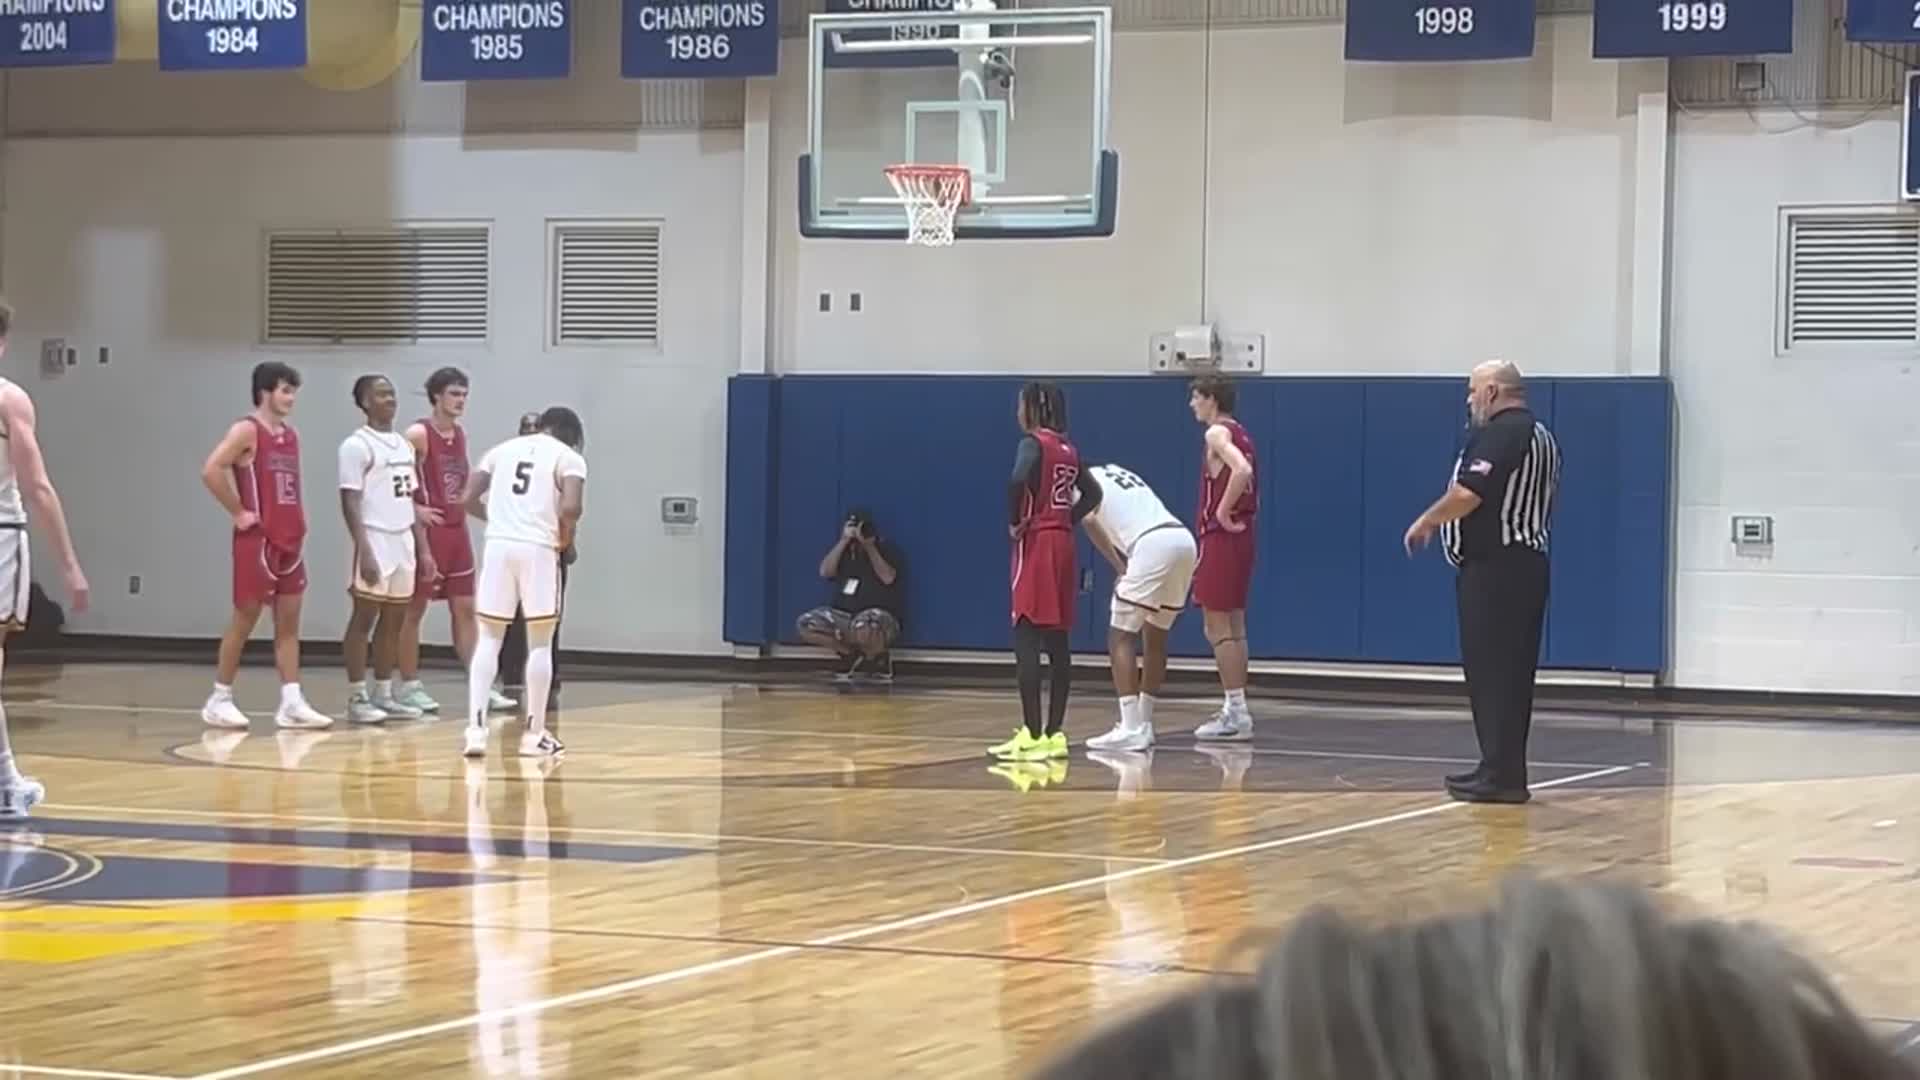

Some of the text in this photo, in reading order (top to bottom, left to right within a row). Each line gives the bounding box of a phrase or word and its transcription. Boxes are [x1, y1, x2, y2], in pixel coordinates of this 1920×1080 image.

[167, 0, 298, 21] CHAMPIONS
[434, 4, 564, 31] CHAMPIONS
[640, 3, 765, 31] CHAMPIONS
[1415, 7, 1474, 34] 1998
[1657, 3, 1726, 31] 1999
[20, 20, 67, 51] 2004
[205, 27, 258, 53] 1984
[470, 35, 523, 60] 1985
[666, 35, 730, 59] 1986
[512, 461, 535, 495] 5
